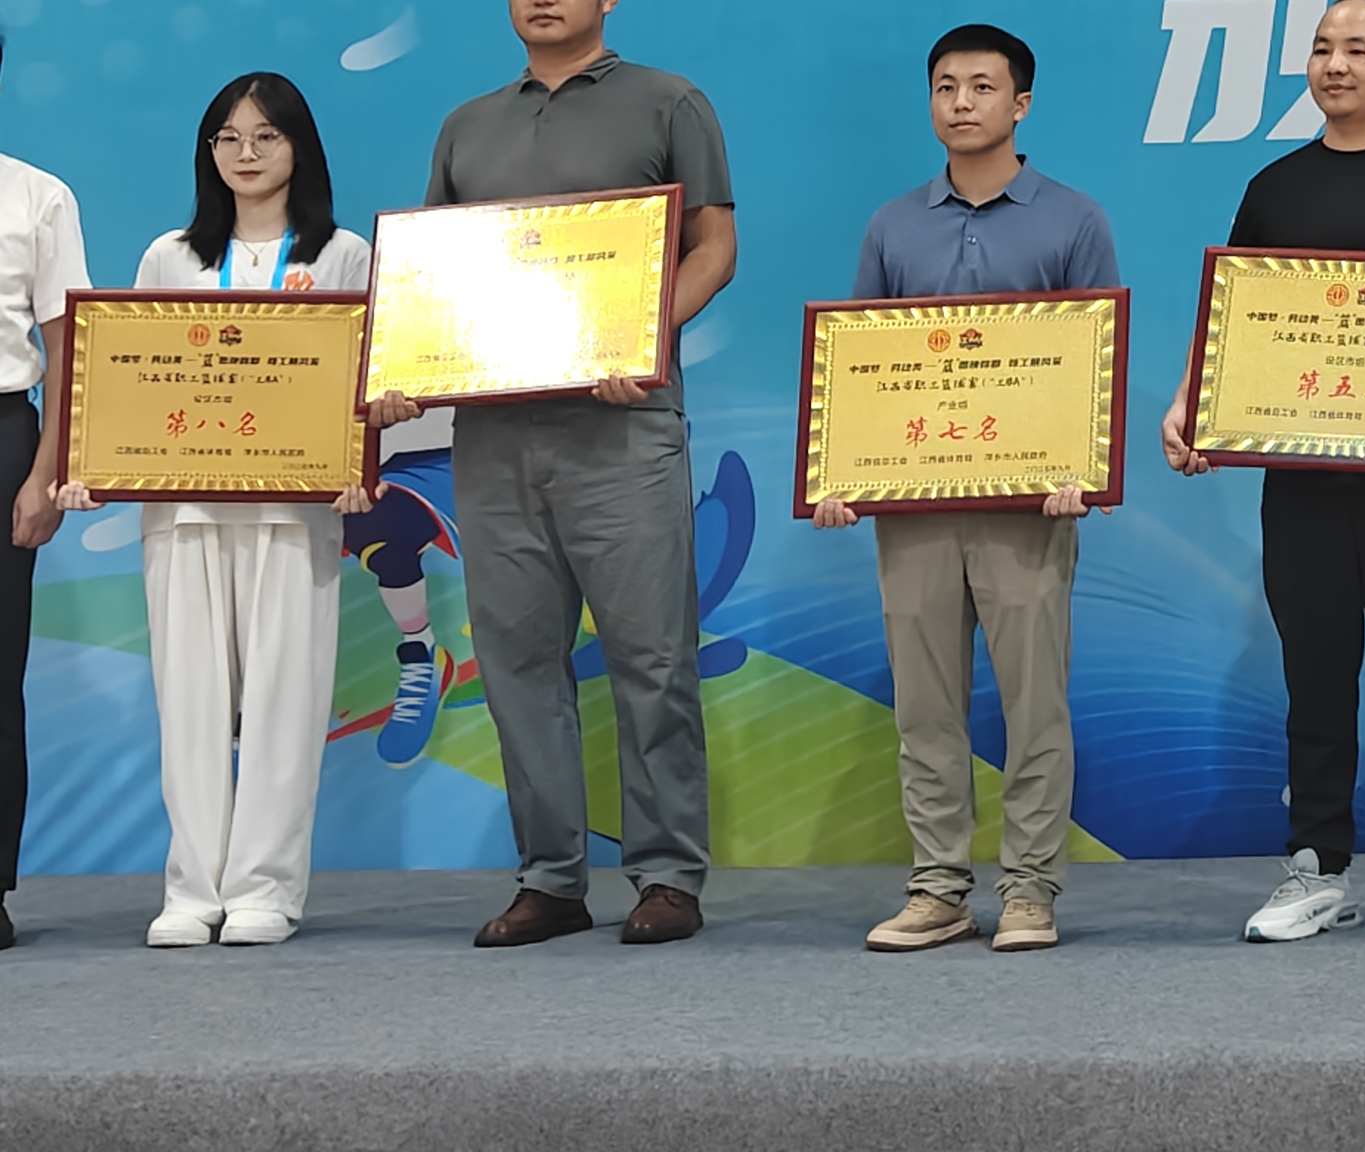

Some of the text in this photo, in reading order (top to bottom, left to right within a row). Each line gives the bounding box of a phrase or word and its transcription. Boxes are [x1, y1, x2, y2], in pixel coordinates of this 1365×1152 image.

[166, 409, 257, 438] 第八名
[905, 415, 998, 447] 第七名
